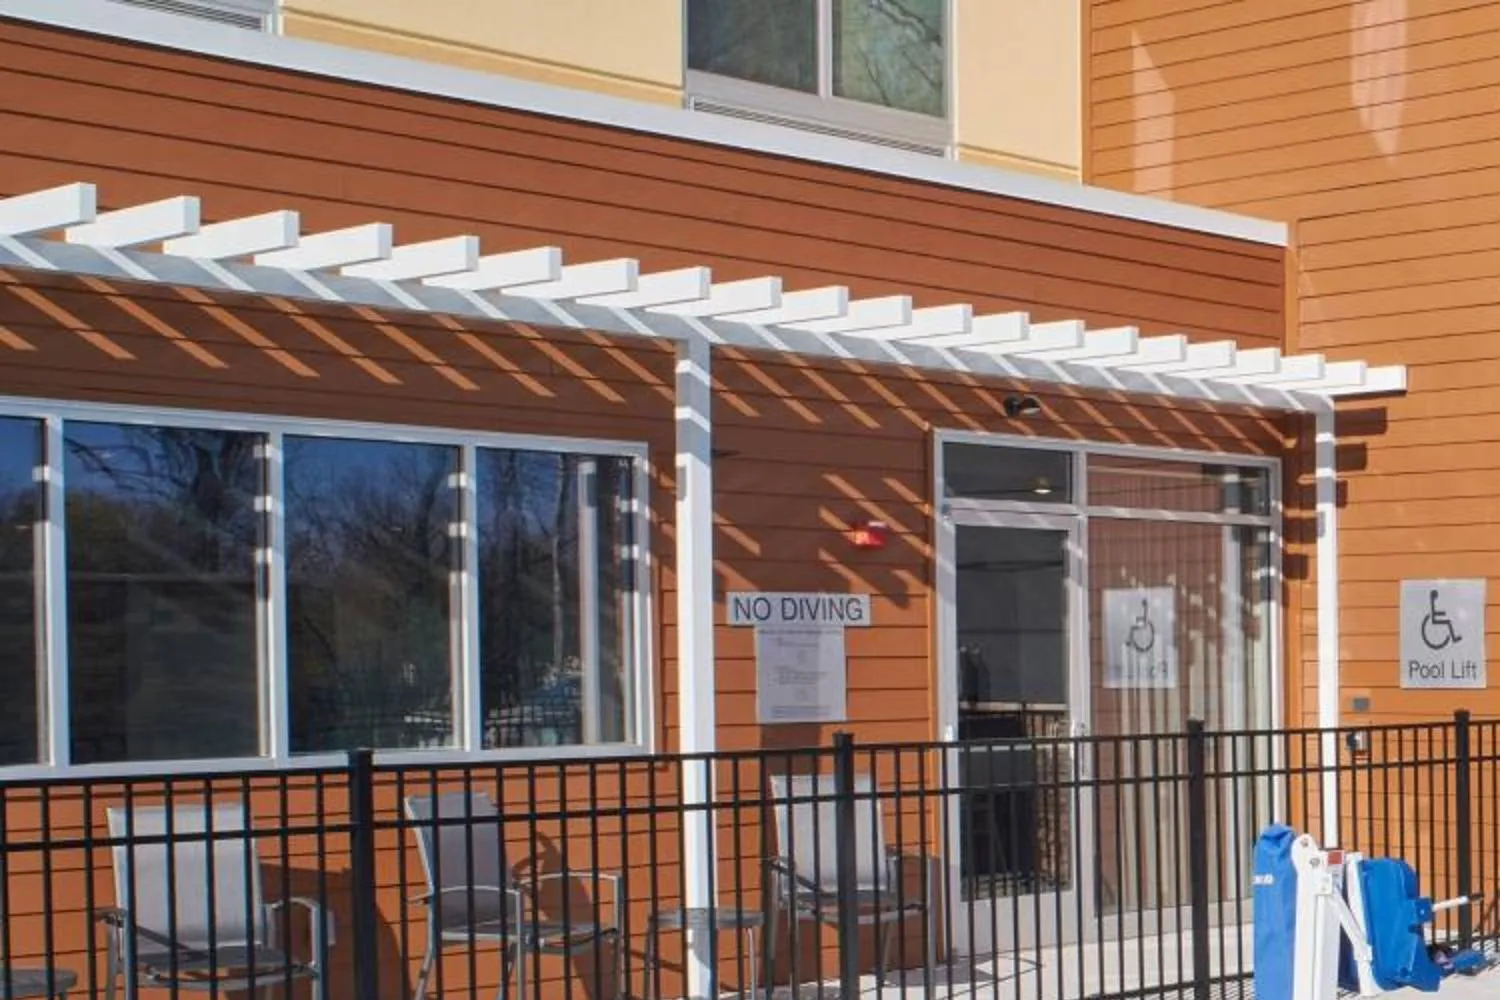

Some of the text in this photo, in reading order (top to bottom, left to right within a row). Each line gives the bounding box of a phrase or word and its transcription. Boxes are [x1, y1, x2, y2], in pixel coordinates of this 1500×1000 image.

[734, 597, 864, 622] NO DIVING
[1408, 660, 1478, 680] Pool Lift
